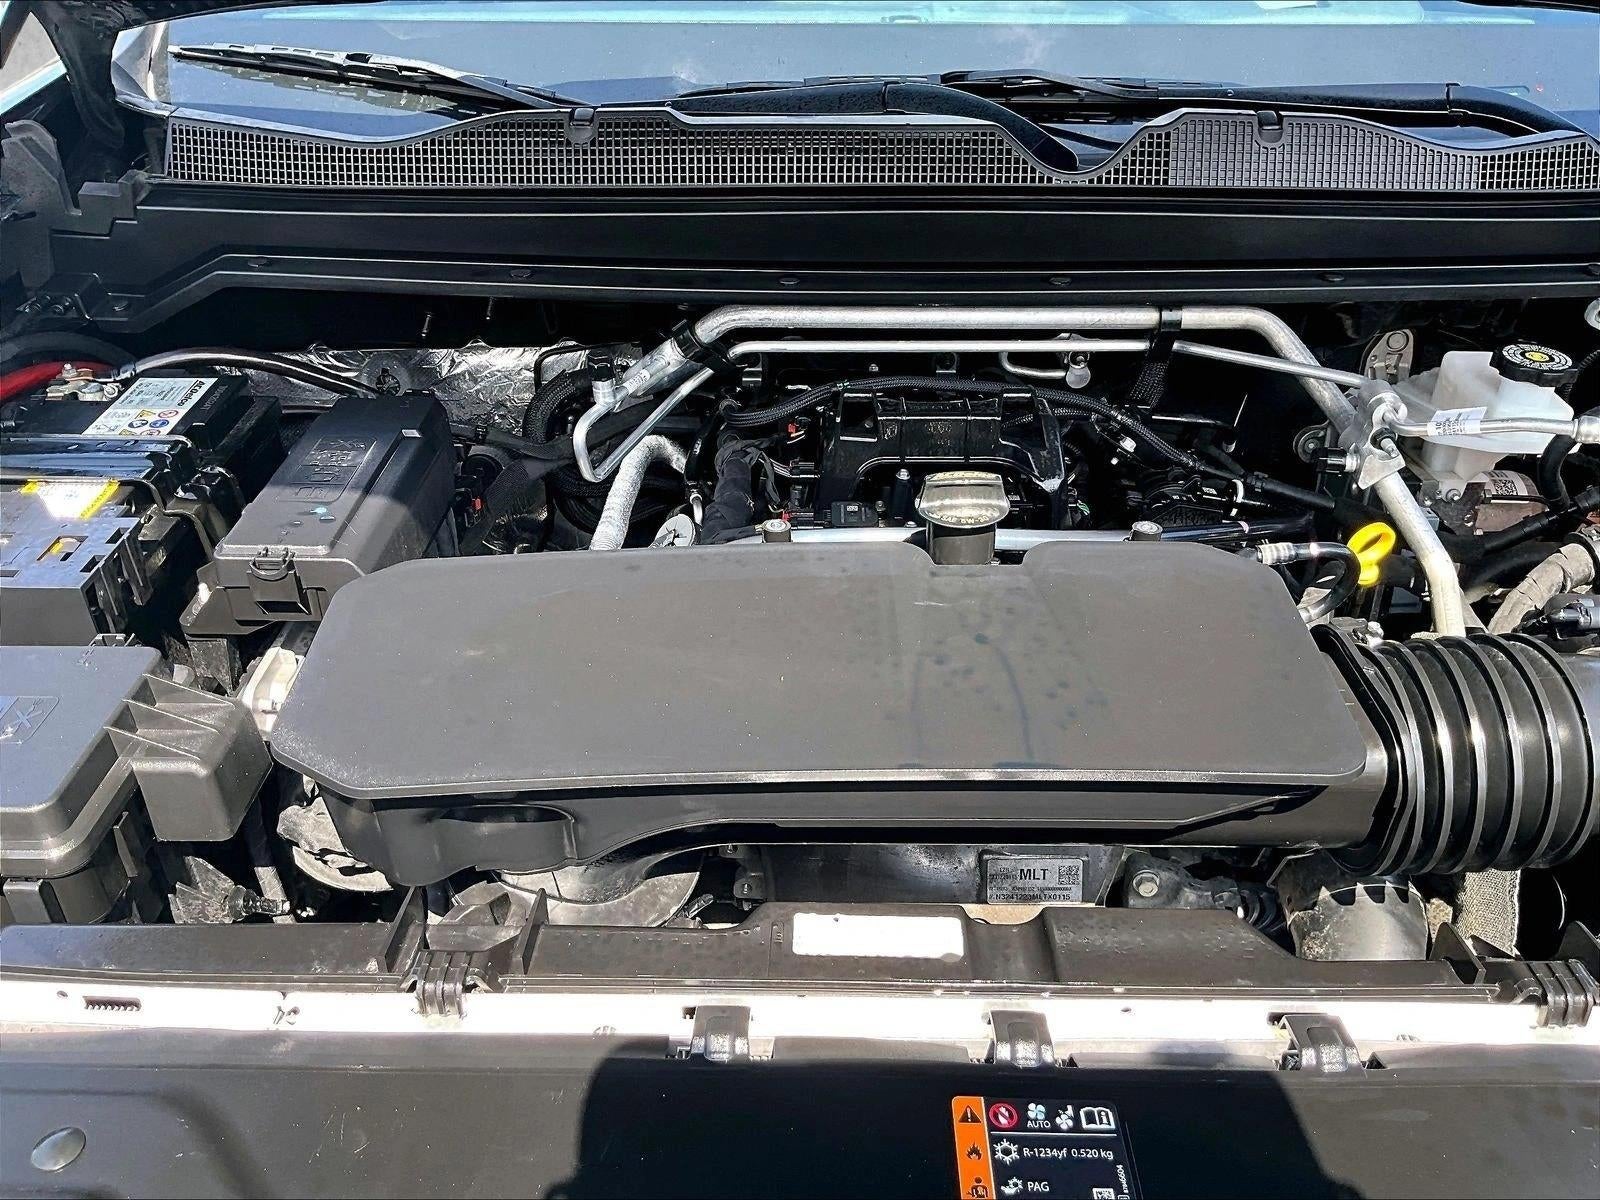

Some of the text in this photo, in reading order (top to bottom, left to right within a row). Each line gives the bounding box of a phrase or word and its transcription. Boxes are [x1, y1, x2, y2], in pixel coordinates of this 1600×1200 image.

[177, 380, 206, 407] ACDelco
[940, 514, 957, 523] SAE
[1018, 868, 1049, 881] MLT
[1026, 1120, 1051, 1128] AUTO
[1023, 1147, 1114, 1160] R-1234yf 0.520 kg
[1027, 1181, 1050, 1192] PAG
